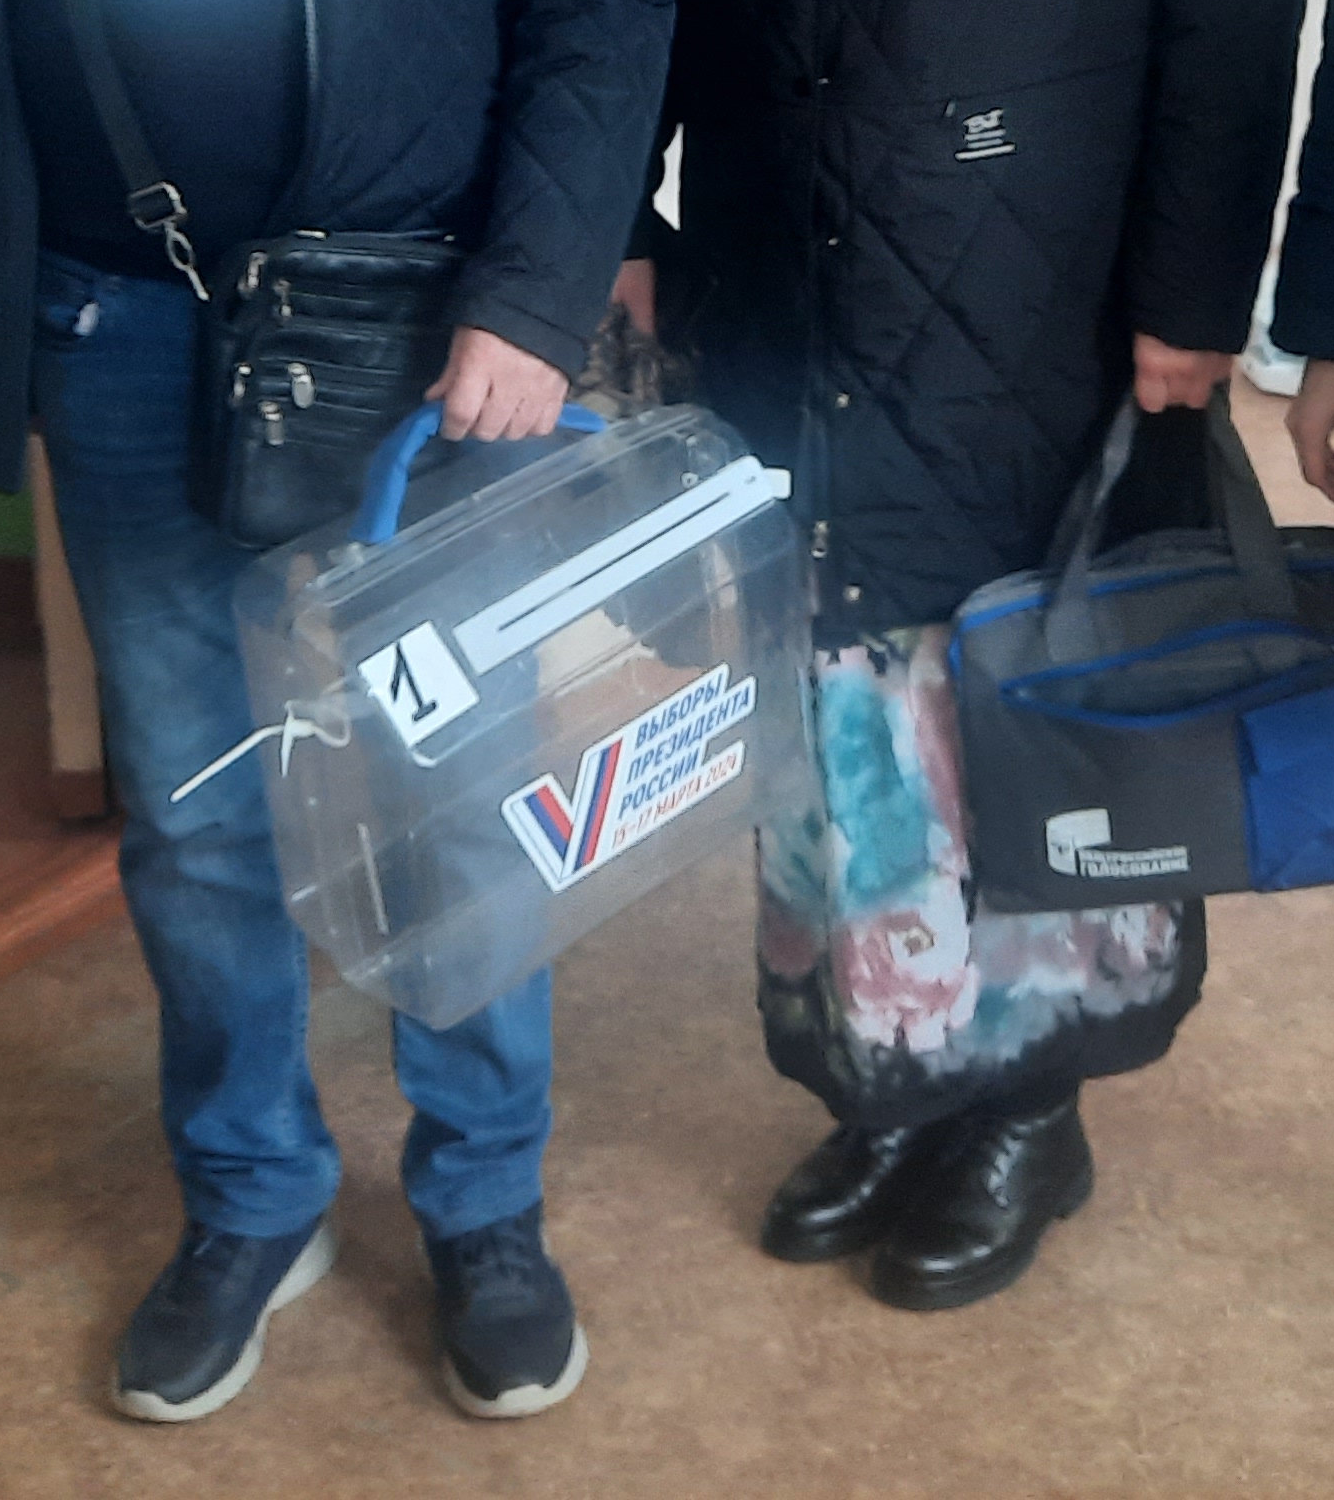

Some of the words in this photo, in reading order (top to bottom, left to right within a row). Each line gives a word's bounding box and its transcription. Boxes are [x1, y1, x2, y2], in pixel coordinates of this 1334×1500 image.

[390, 639, 437, 722] 1
[635, 673, 724, 751] ВЫБОРЫ
[626, 685, 750, 784] ПРЕЗИДЕНТА
[618, 747, 701, 821] РОССИИ
